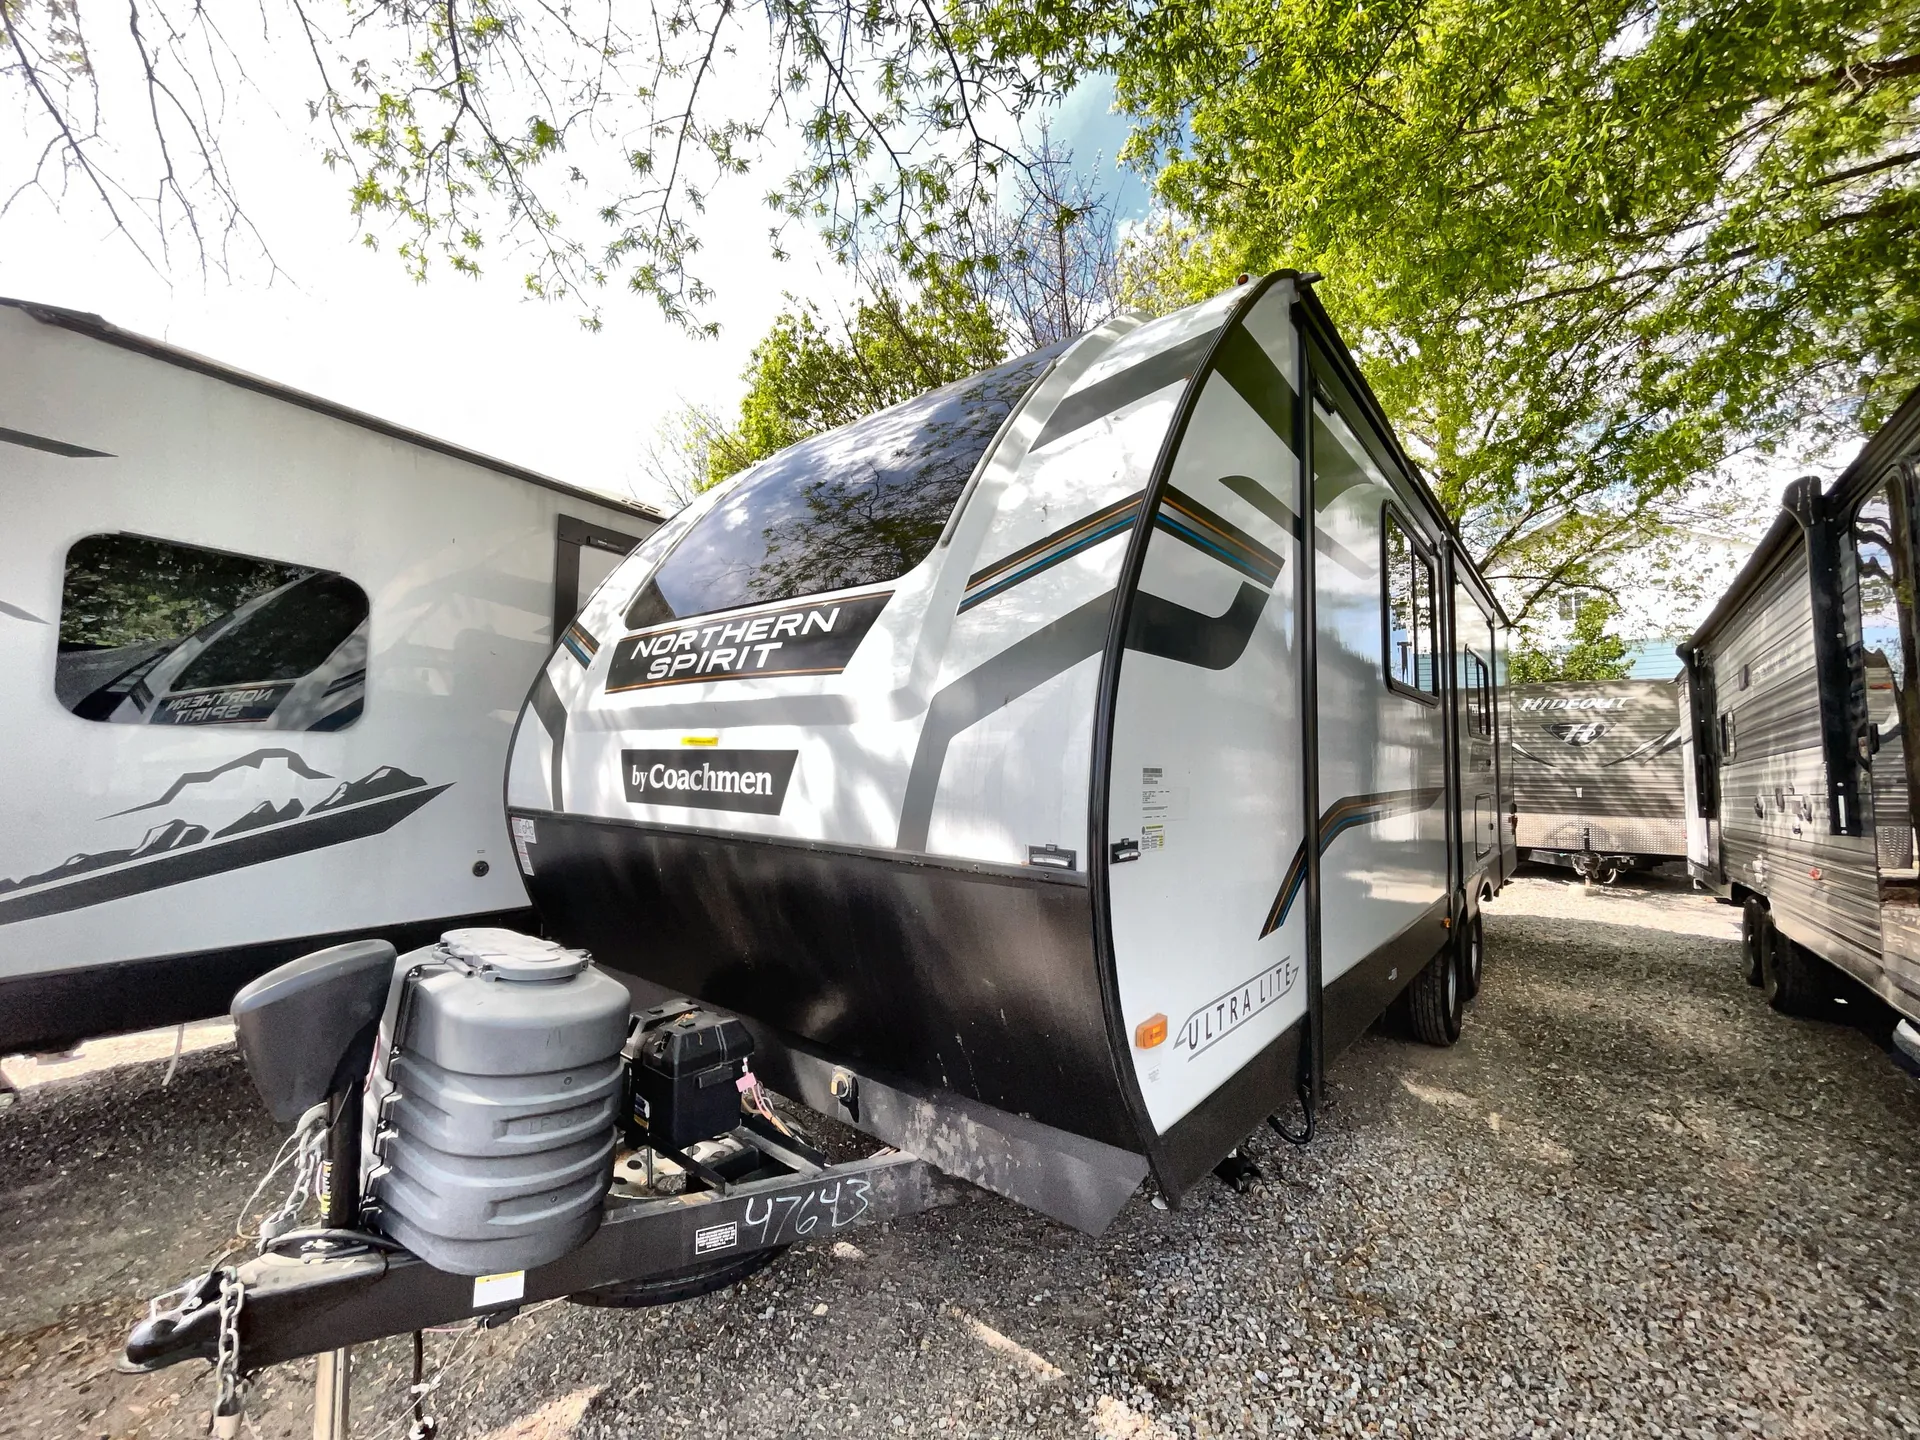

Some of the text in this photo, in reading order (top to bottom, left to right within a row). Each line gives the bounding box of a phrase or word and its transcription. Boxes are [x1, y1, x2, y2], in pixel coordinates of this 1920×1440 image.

[631, 608, 840, 660] NORTHERN
[647, 643, 783, 679] SPIRIT
[1519, 697, 1636, 711] HIDEOUT
[632, 762, 773, 795] by Coachmen
[1188, 963, 1290, 1050] ULTRA LITE
[745, 1179, 871, 1243] 47643
